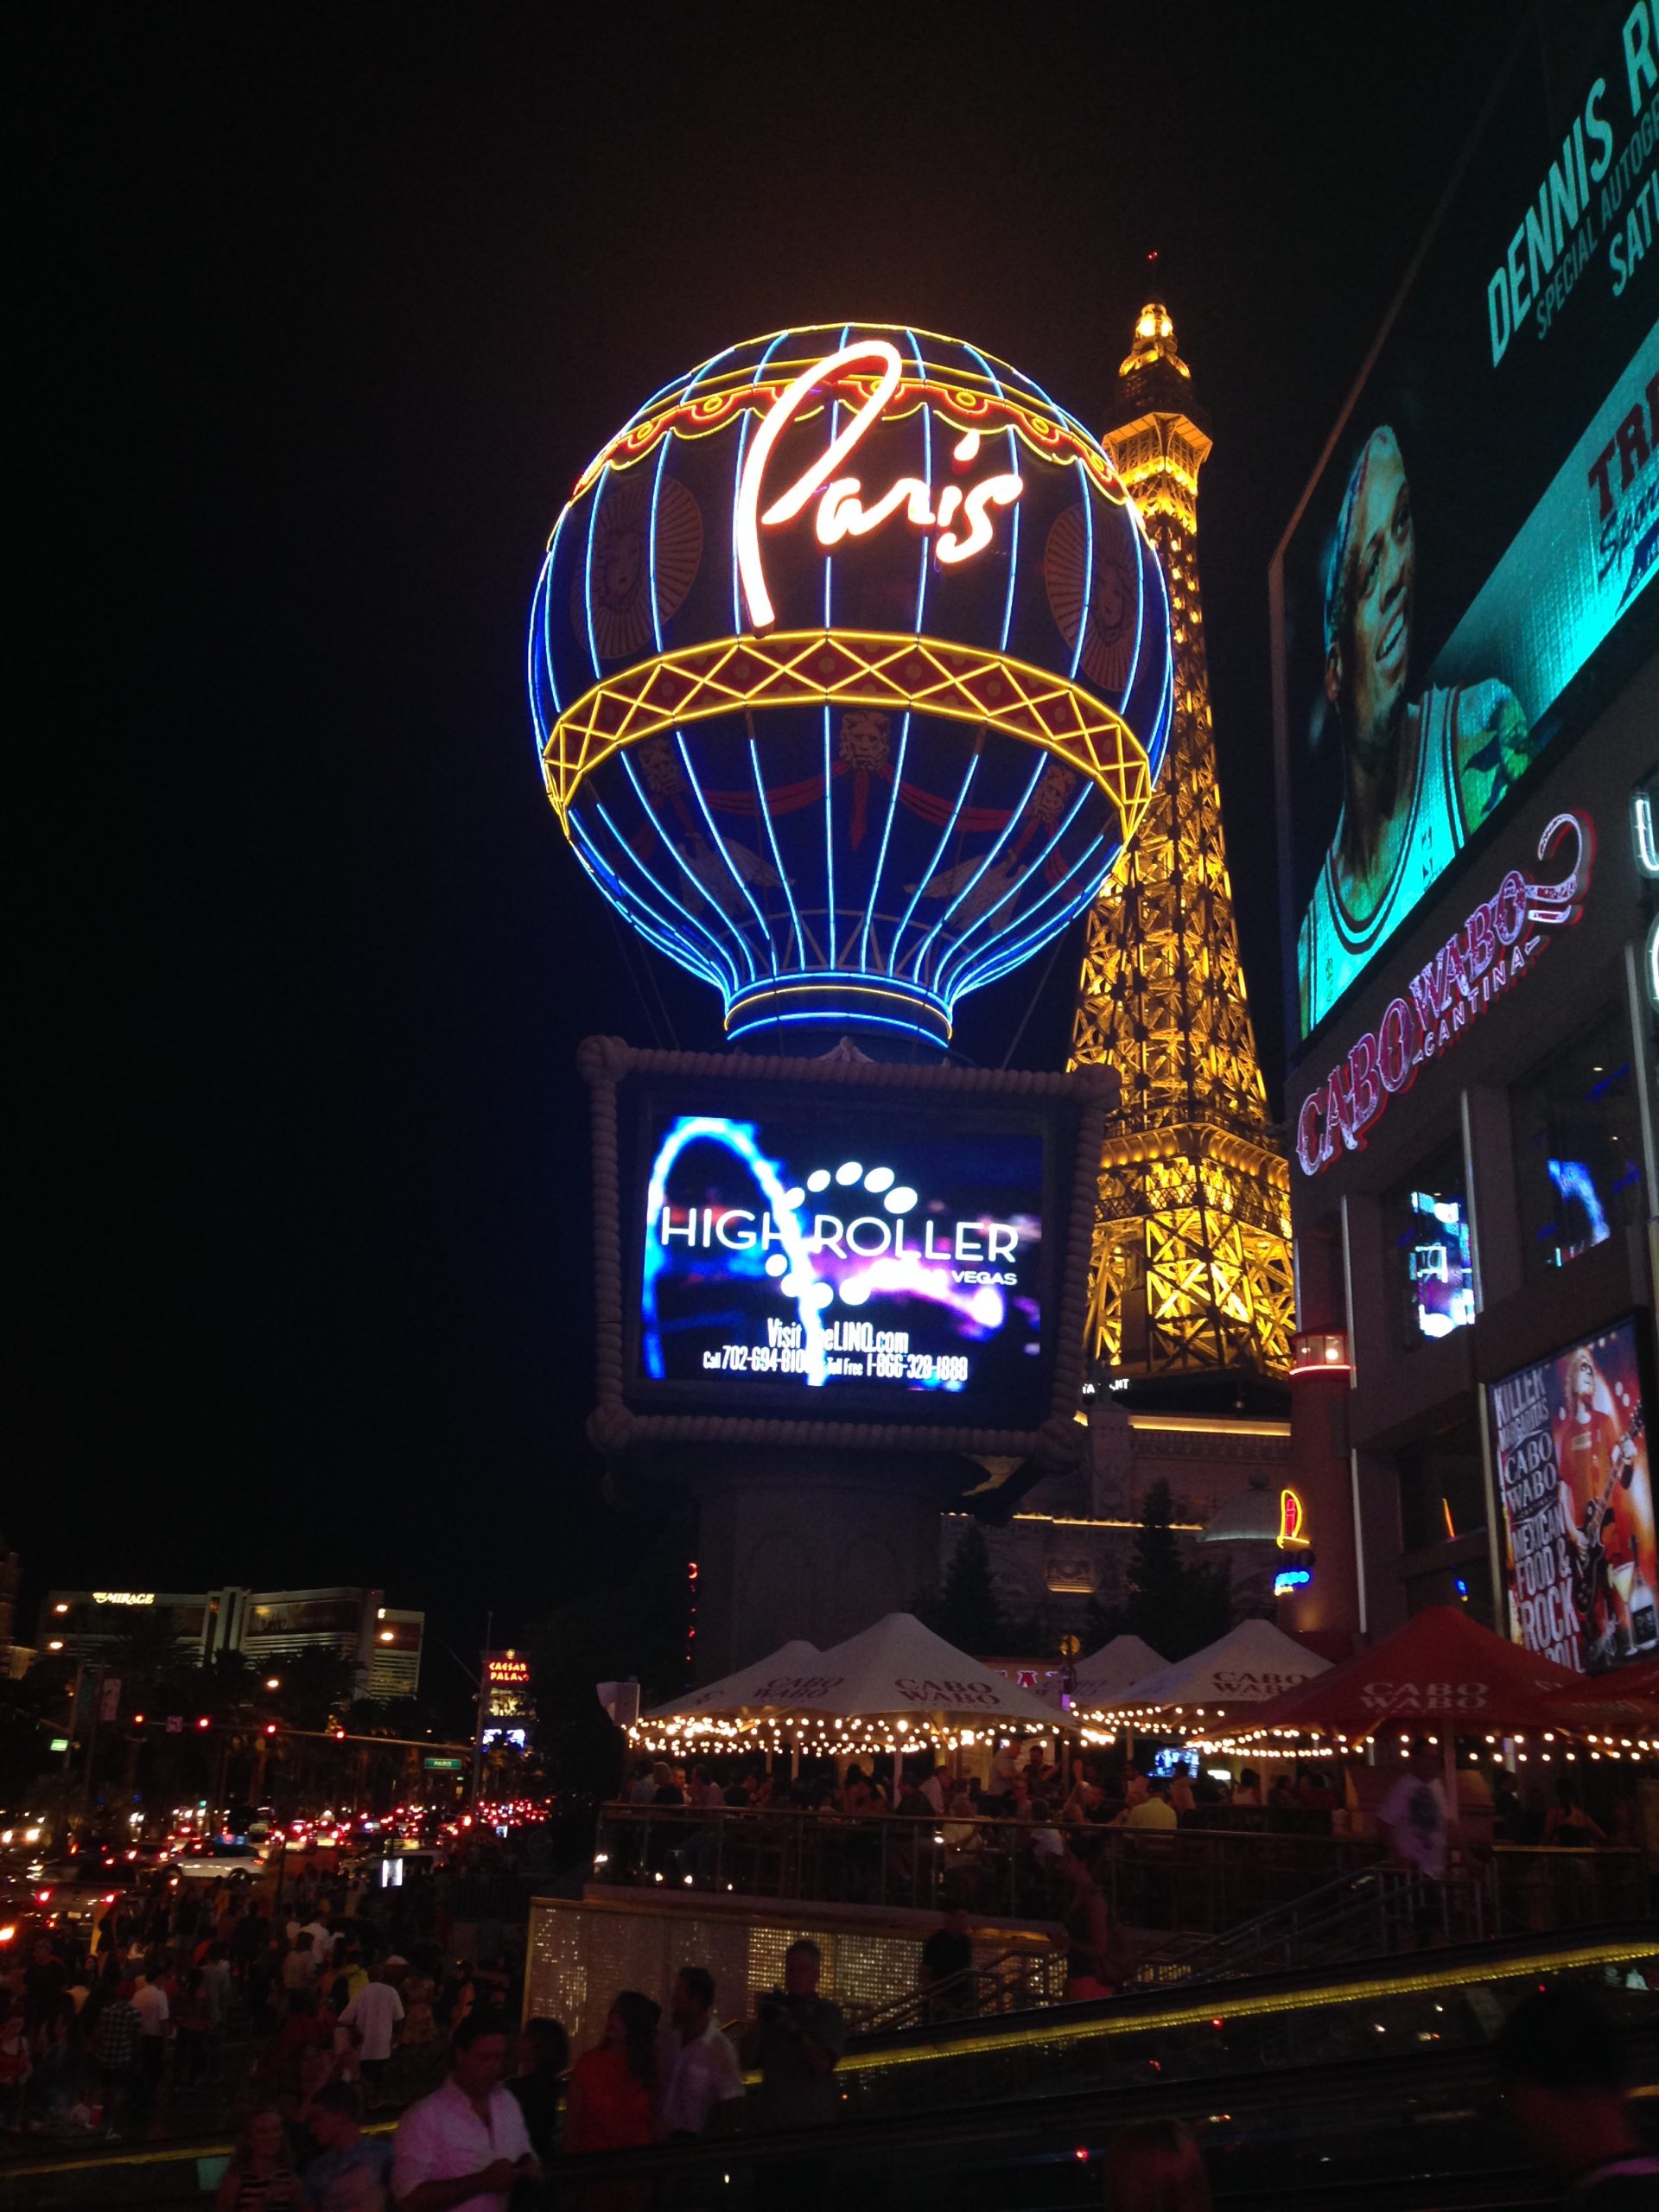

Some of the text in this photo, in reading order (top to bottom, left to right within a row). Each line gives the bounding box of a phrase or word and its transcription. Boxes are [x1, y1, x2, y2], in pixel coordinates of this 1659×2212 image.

[1487, 76, 1613, 369] DENNIS
[1535, 215, 1599, 340] SPECIAL
[736, 340, 1023, 627] Paris
[1296, 869, 1531, 1176] CABO WABO
[1422, 945, 1525, 1058] CANTINA
[661, 1206, 1020, 1263] HIGH ROLLER
[950, 1270, 1018, 1286] VEGAS
[767, 1318, 909, 1354] Visit eLINQ.com
[702, 1351, 721, 1369] Call
[721, 1345, 813, 1373] 702-694-810
[843, 1358, 863, 1376] Free
[867, 1352, 969, 1382] 1-866-328-1888
[1493, 1368, 1548, 1428] KILLER
[1504, 1431, 1554, 1484] CABO
[1507, 1462, 1557, 1512] WABO
[1512, 1504, 1567, 1562] MEXICAN
[1516, 1536, 1573, 1602] FOOD &
[108, 1592, 155, 1605] MIRAGE
[1521, 1577, 1581, 1653] ROCK
[753, 1688, 830, 1700] WABO
[767, 1676, 844, 1688] CABO
[894, 1678, 994, 1694] CABO
[897, 1689, 1000, 1706] WABO
[1211, 1671, 1309, 1685] CABO
[1211, 1681, 1287, 1694] WAB
[1362, 1682, 1490, 1697] CABO
[1358, 1695, 1488, 1709] WABO
